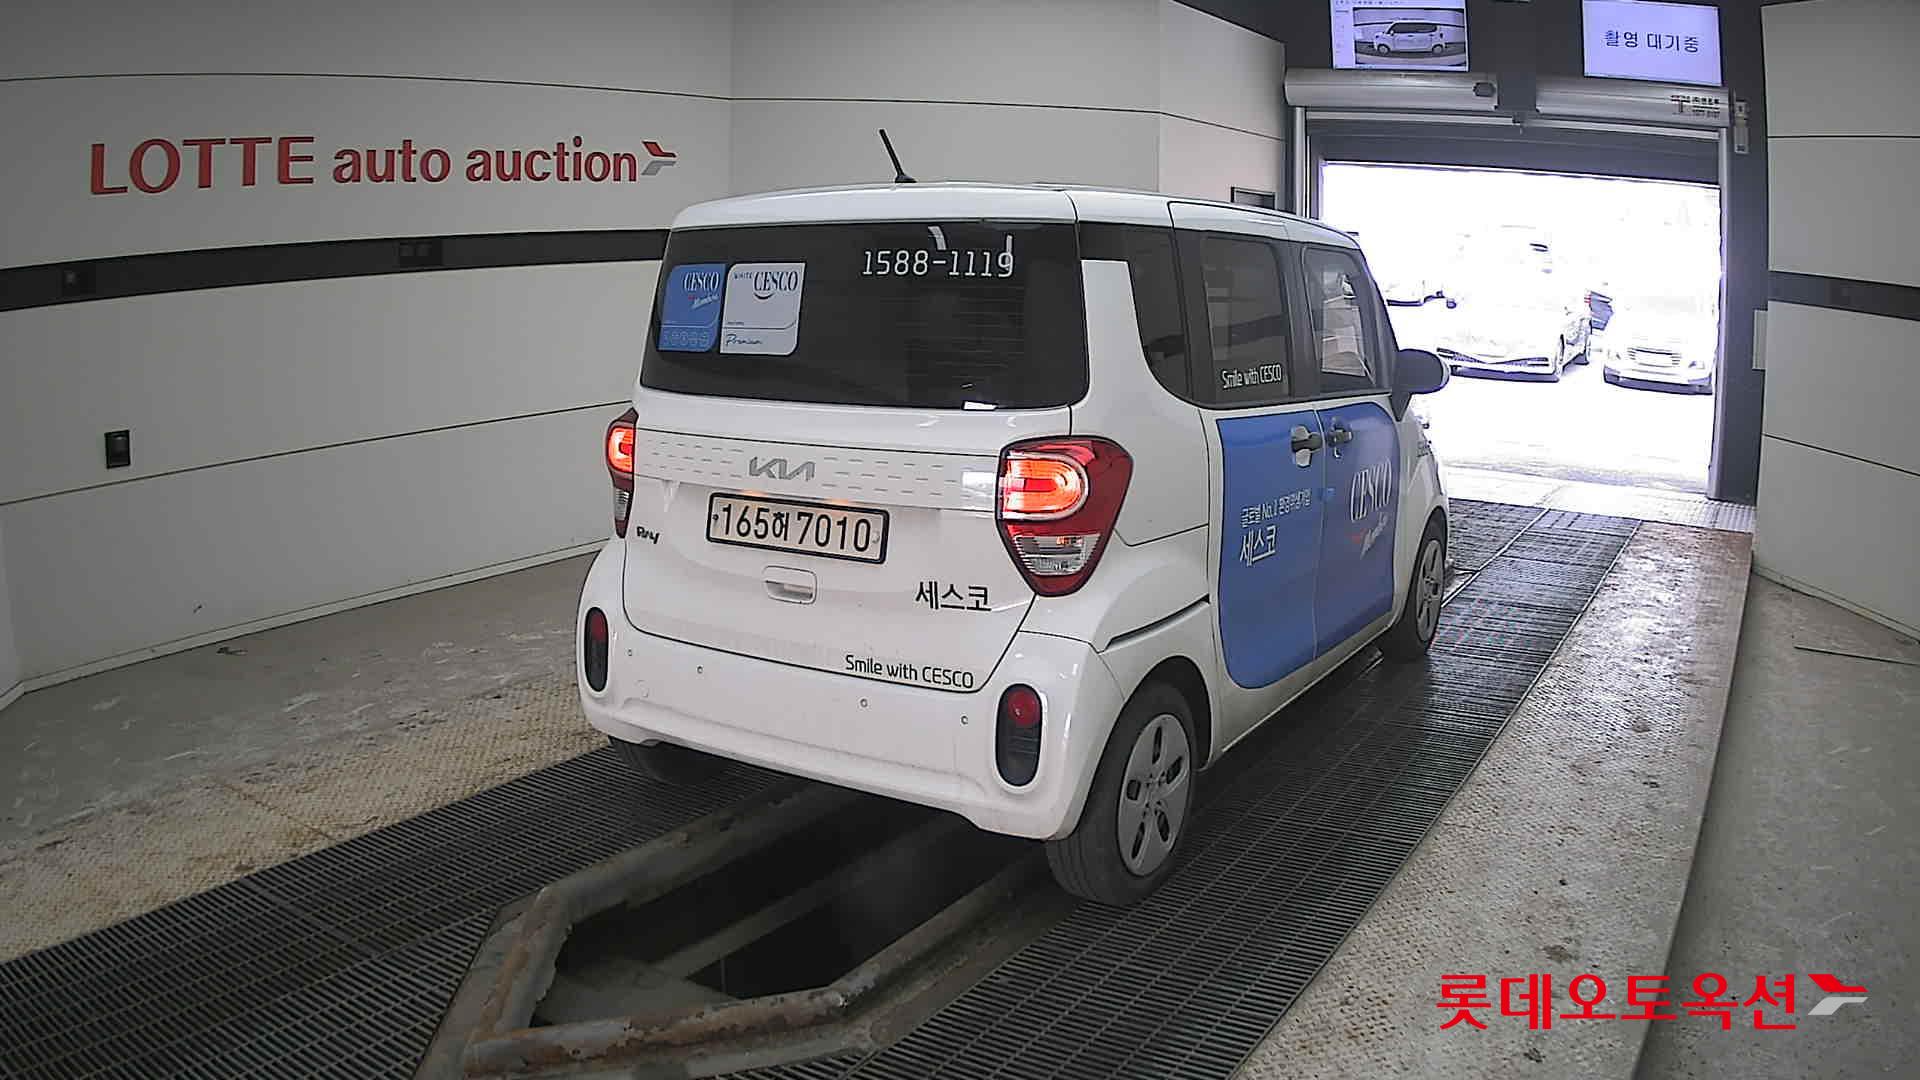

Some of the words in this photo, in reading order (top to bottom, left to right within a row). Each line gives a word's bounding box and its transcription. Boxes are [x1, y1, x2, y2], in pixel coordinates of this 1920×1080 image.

[1604, 30, 1638, 48] 촬영
[90, 136, 315, 195] LOTTE
[332, 139, 452, 184] auto
[465, 136, 638, 183] auction
[862, 250, 1015, 278] 1588-1119
[753, 270, 799, 292] CESCO
[1222, 369, 1243, 389] Smile
[1243, 367, 1260, 385] with
[1260, 363, 1282, 383] CESCO
[1350, 457, 1392, 523] CESCO
[722, 503, 790, 541] 165허
[796, 512, 872, 552] 7010
[1240, 525, 1277, 568] 세스코
[915, 580, 992, 612] 세스코
[845, 654, 882, 675] Smile
[886, 663, 918, 681] with
[922, 666, 974, 689] CESCO
